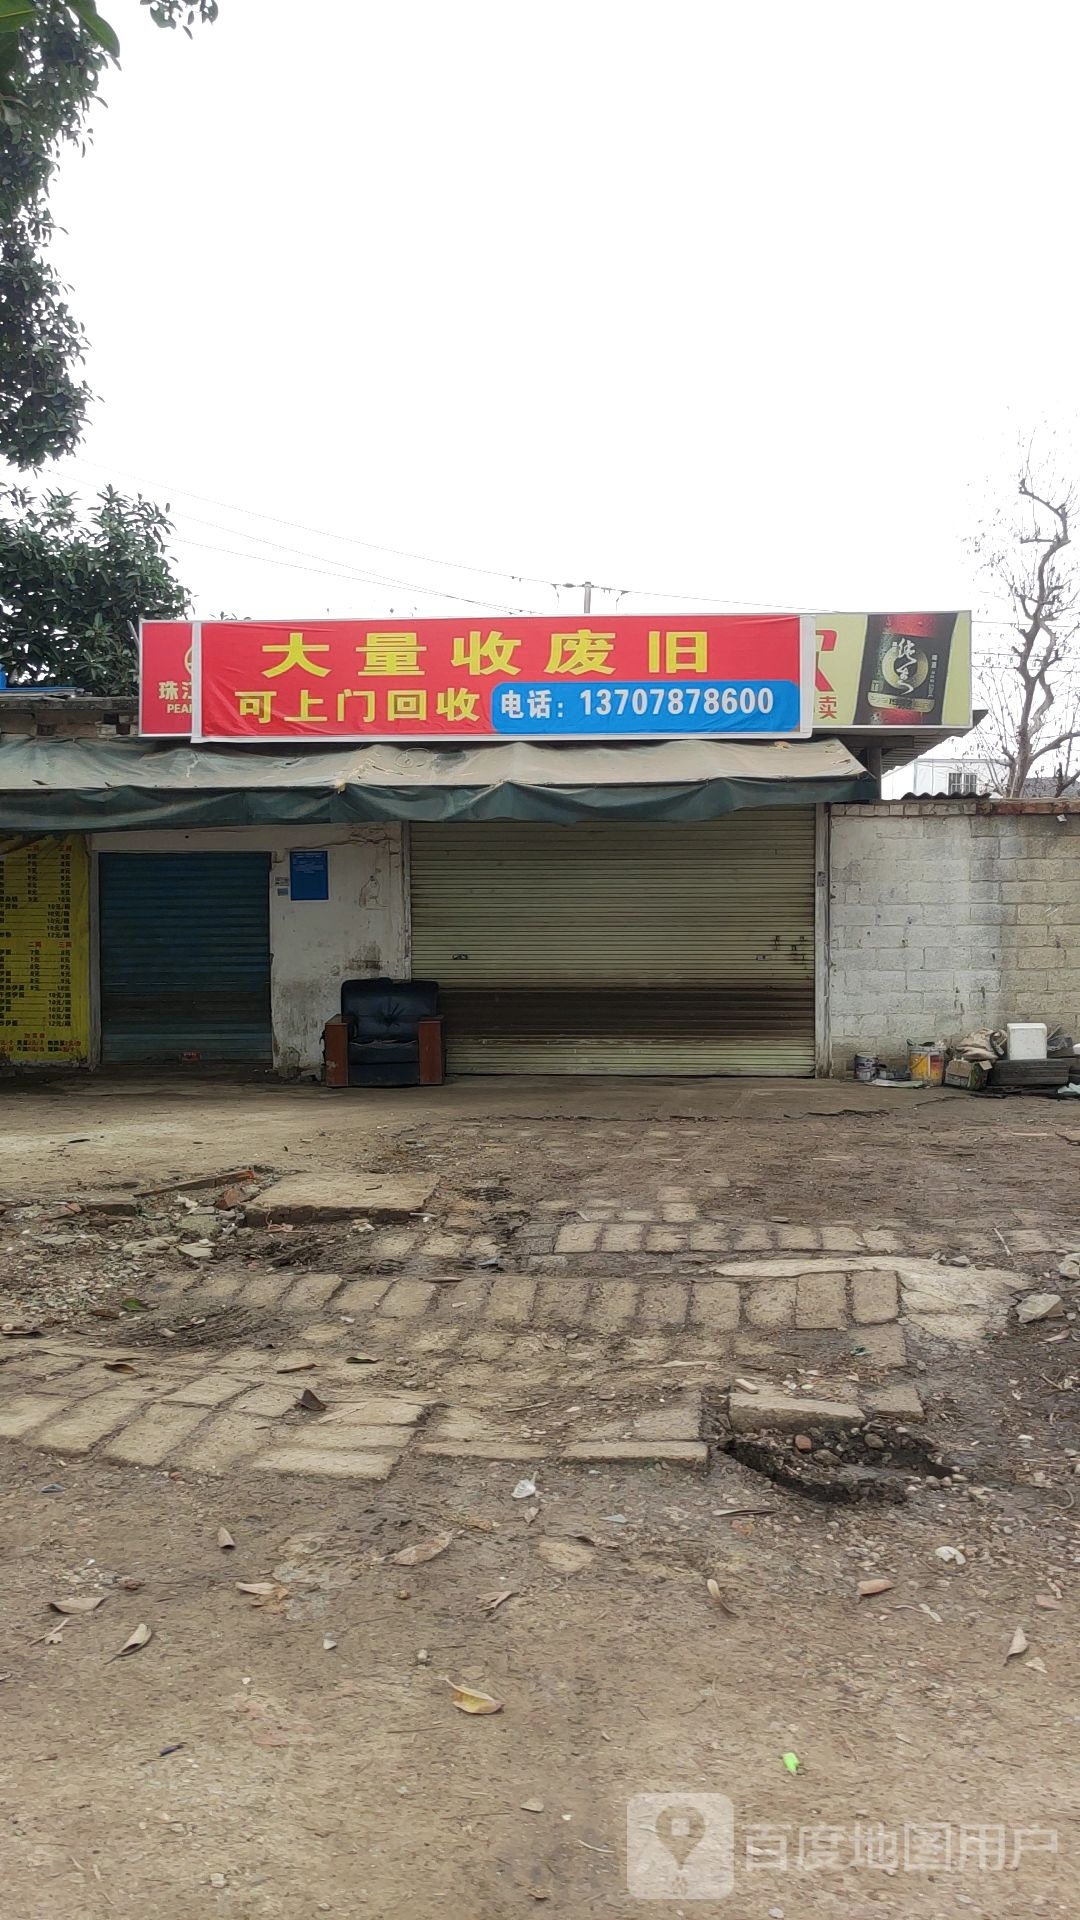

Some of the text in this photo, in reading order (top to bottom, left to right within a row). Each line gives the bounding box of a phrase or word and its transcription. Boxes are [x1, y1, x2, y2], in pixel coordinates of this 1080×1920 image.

[262, 630, 708, 678] 大量收废旧
[234, 687, 480, 723] 可上门回收
[580, 687, 774, 716] 13707878600
